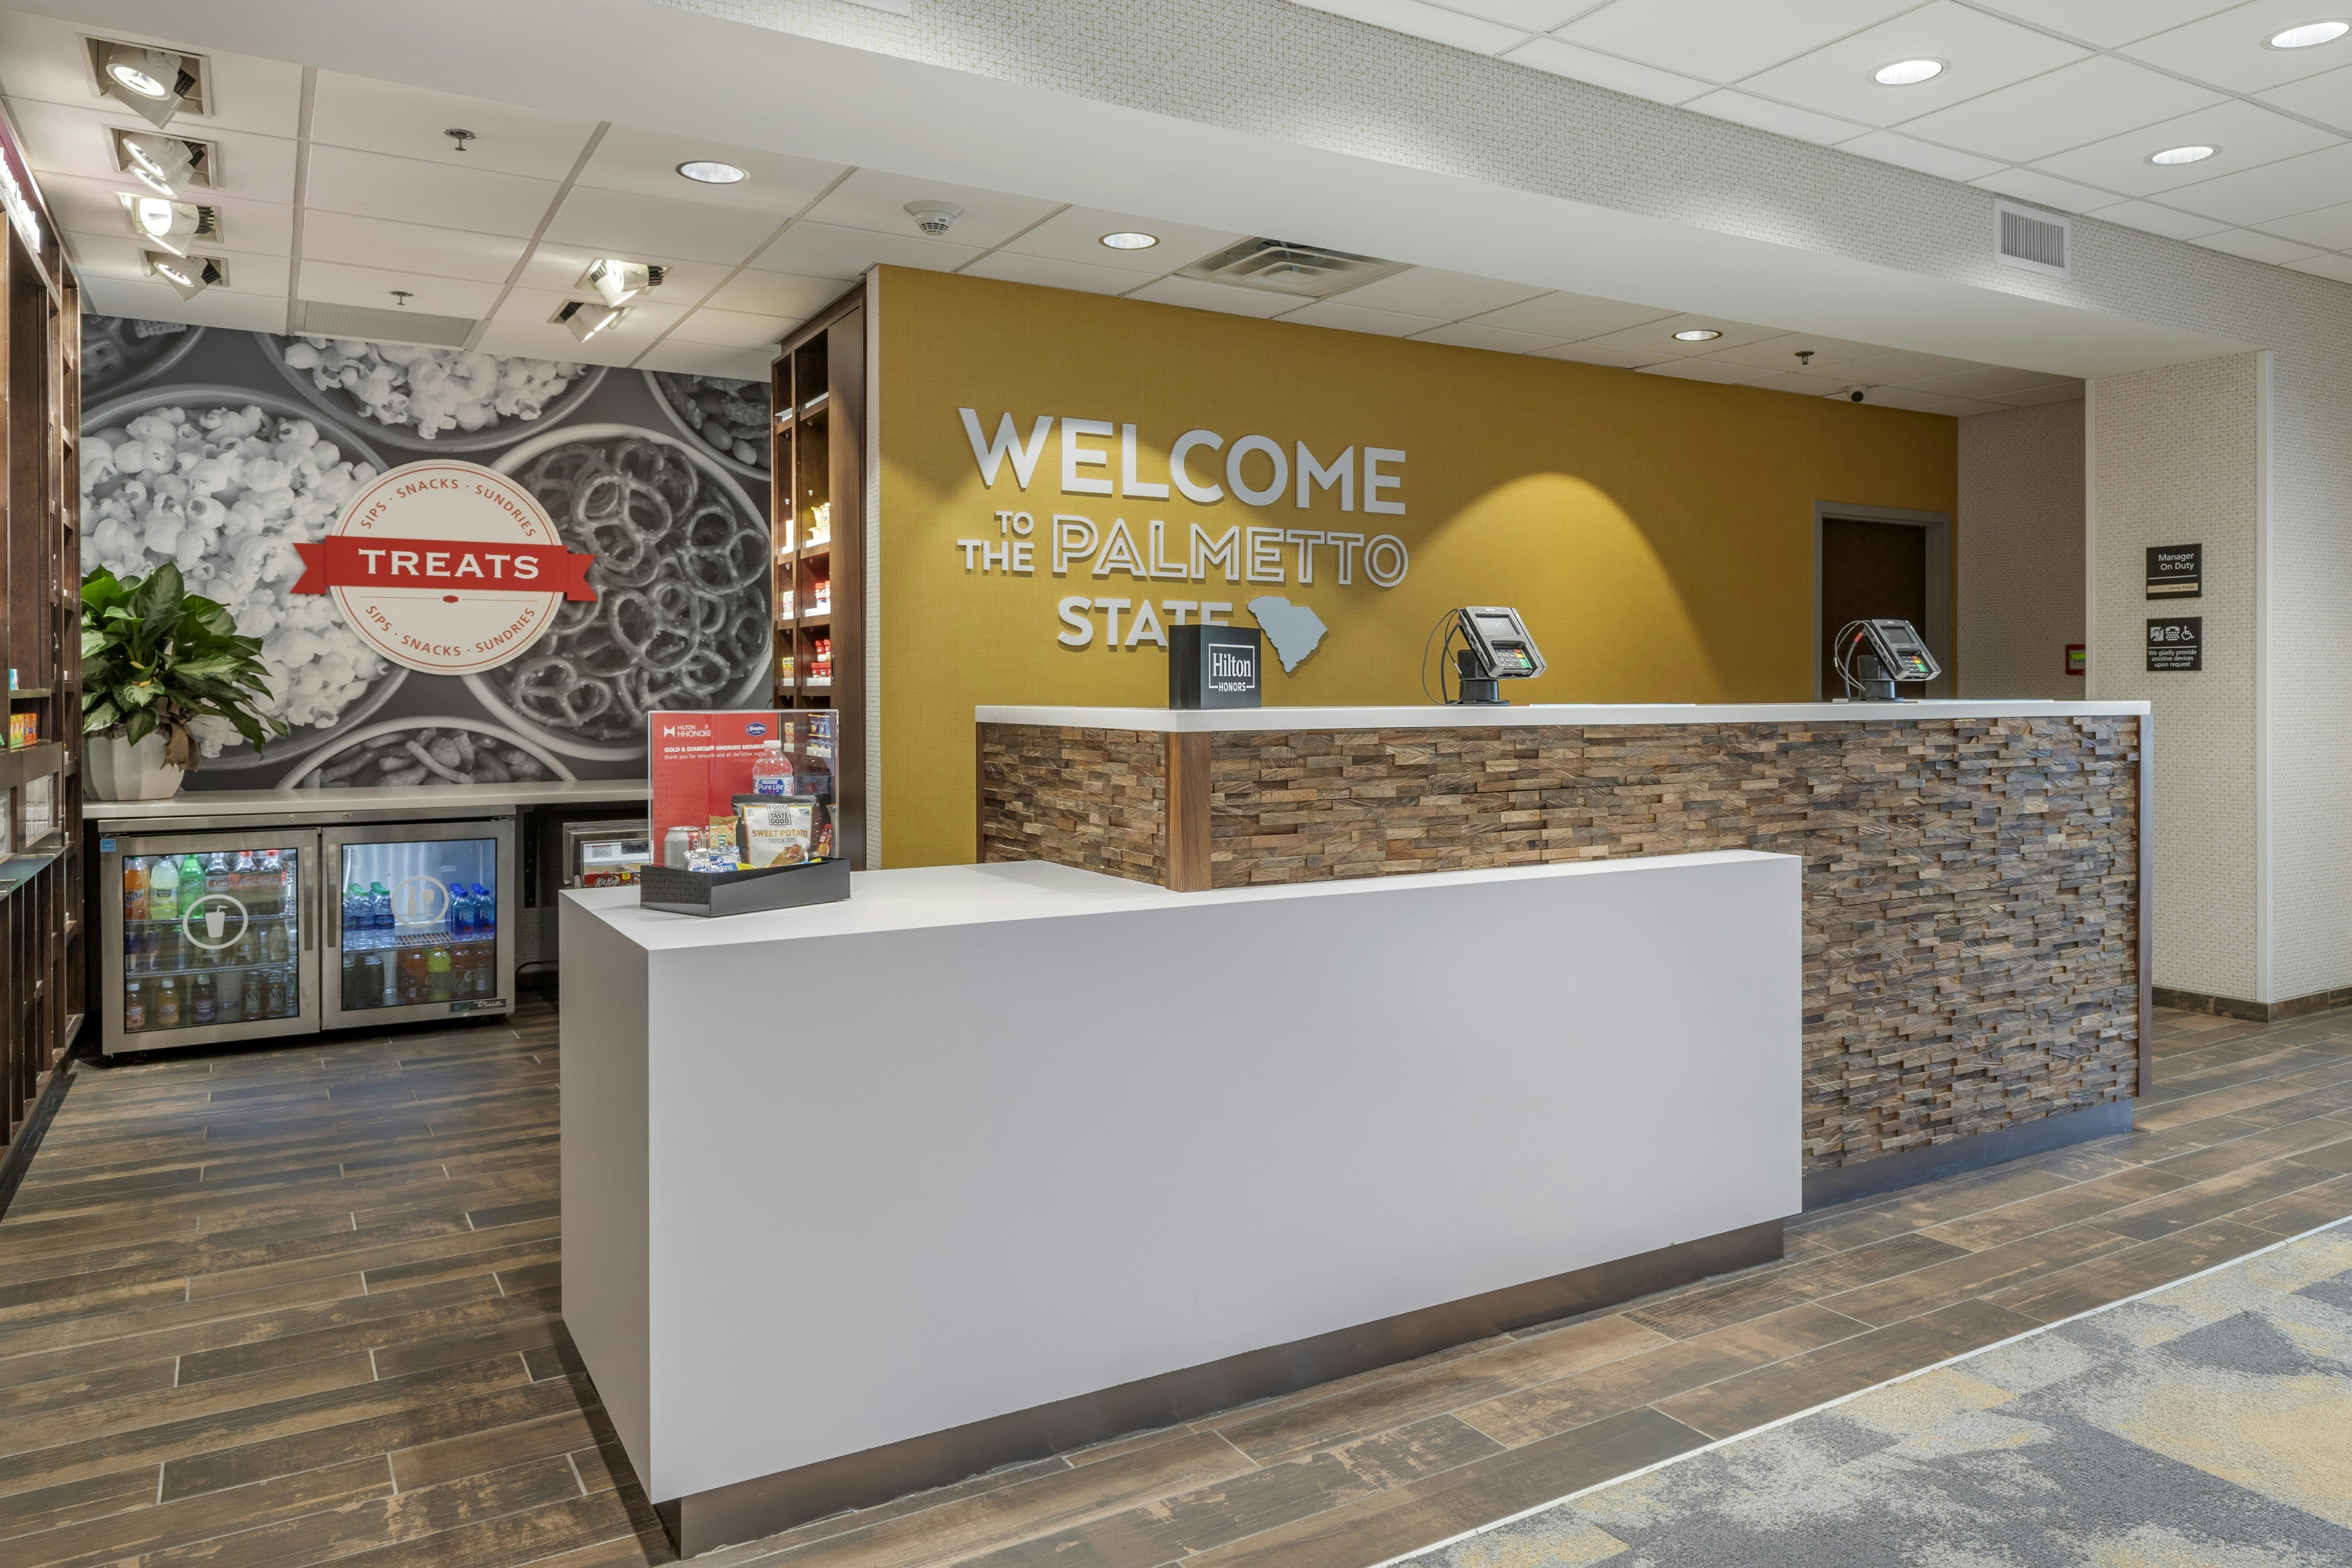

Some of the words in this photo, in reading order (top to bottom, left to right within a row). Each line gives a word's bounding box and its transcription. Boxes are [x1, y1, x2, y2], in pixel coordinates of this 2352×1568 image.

[958, 407, 1406, 516] WELCOME
[361, 501, 387, 529] SIPS
[397, 478, 459, 499] SNACKS
[475, 485, 536, 537] SUNDRIES
[994, 510, 1034, 535] TO
[957, 539, 1035, 572] THE
[1052, 514, 1409, 588] PALMETTO
[2158, 553, 2194, 562] Manager
[358, 548, 540, 580] TREATS
[366, 605, 392, 632] SIPS
[401, 635, 461, 656] SNACKS
[476, 608, 535, 653] SUNDRIES
[1212, 653, 1252, 677] Hilton
[1218, 682, 1246, 692] HONORS
[125, 892, 143, 903] anta
[271, 989, 282, 999] V8
